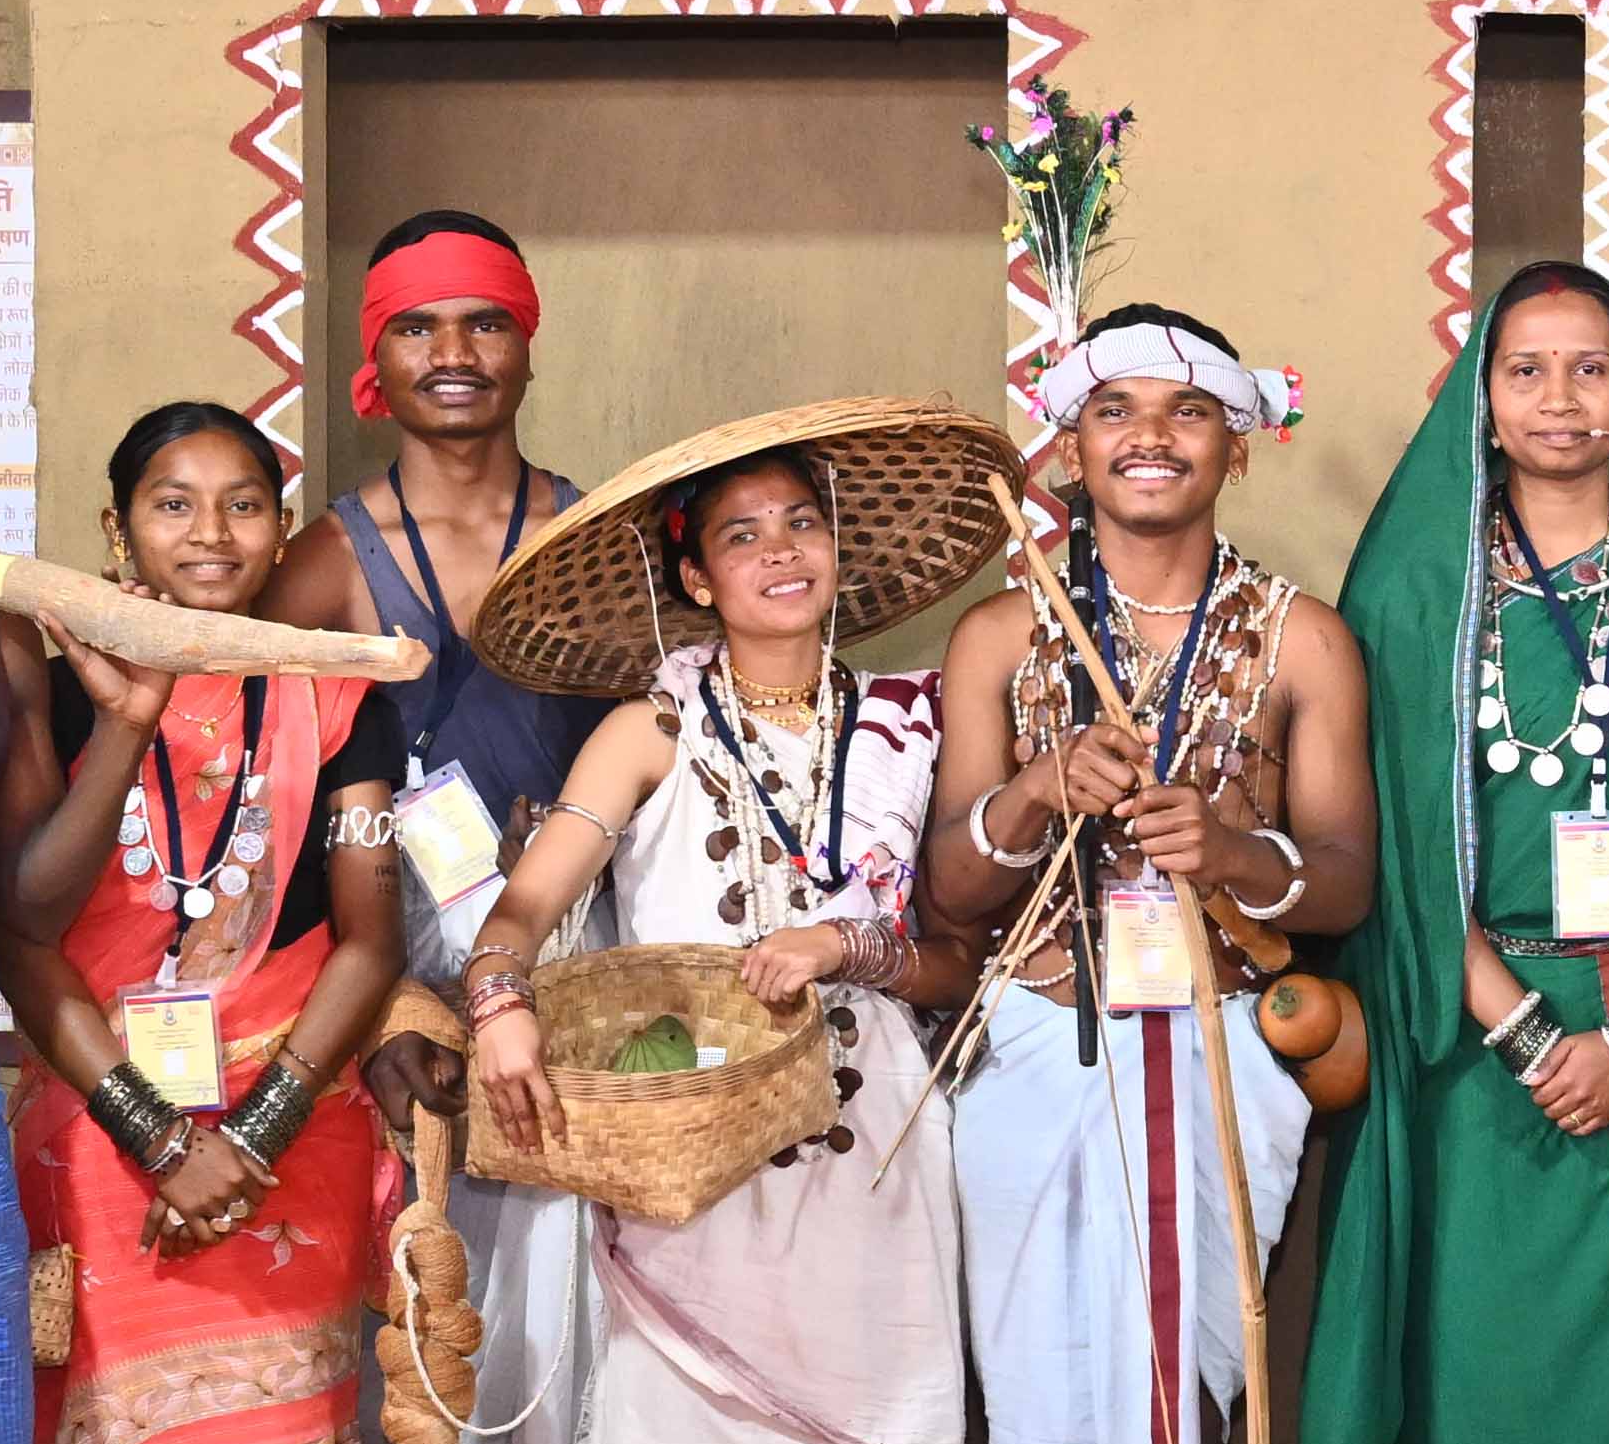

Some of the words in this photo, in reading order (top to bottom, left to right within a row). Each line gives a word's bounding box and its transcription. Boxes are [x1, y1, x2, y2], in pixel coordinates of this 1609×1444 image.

[2, 278, 21, 297] की
[6, 310, 29, 324] रूप
[4, 529, 24, 541] रूप
